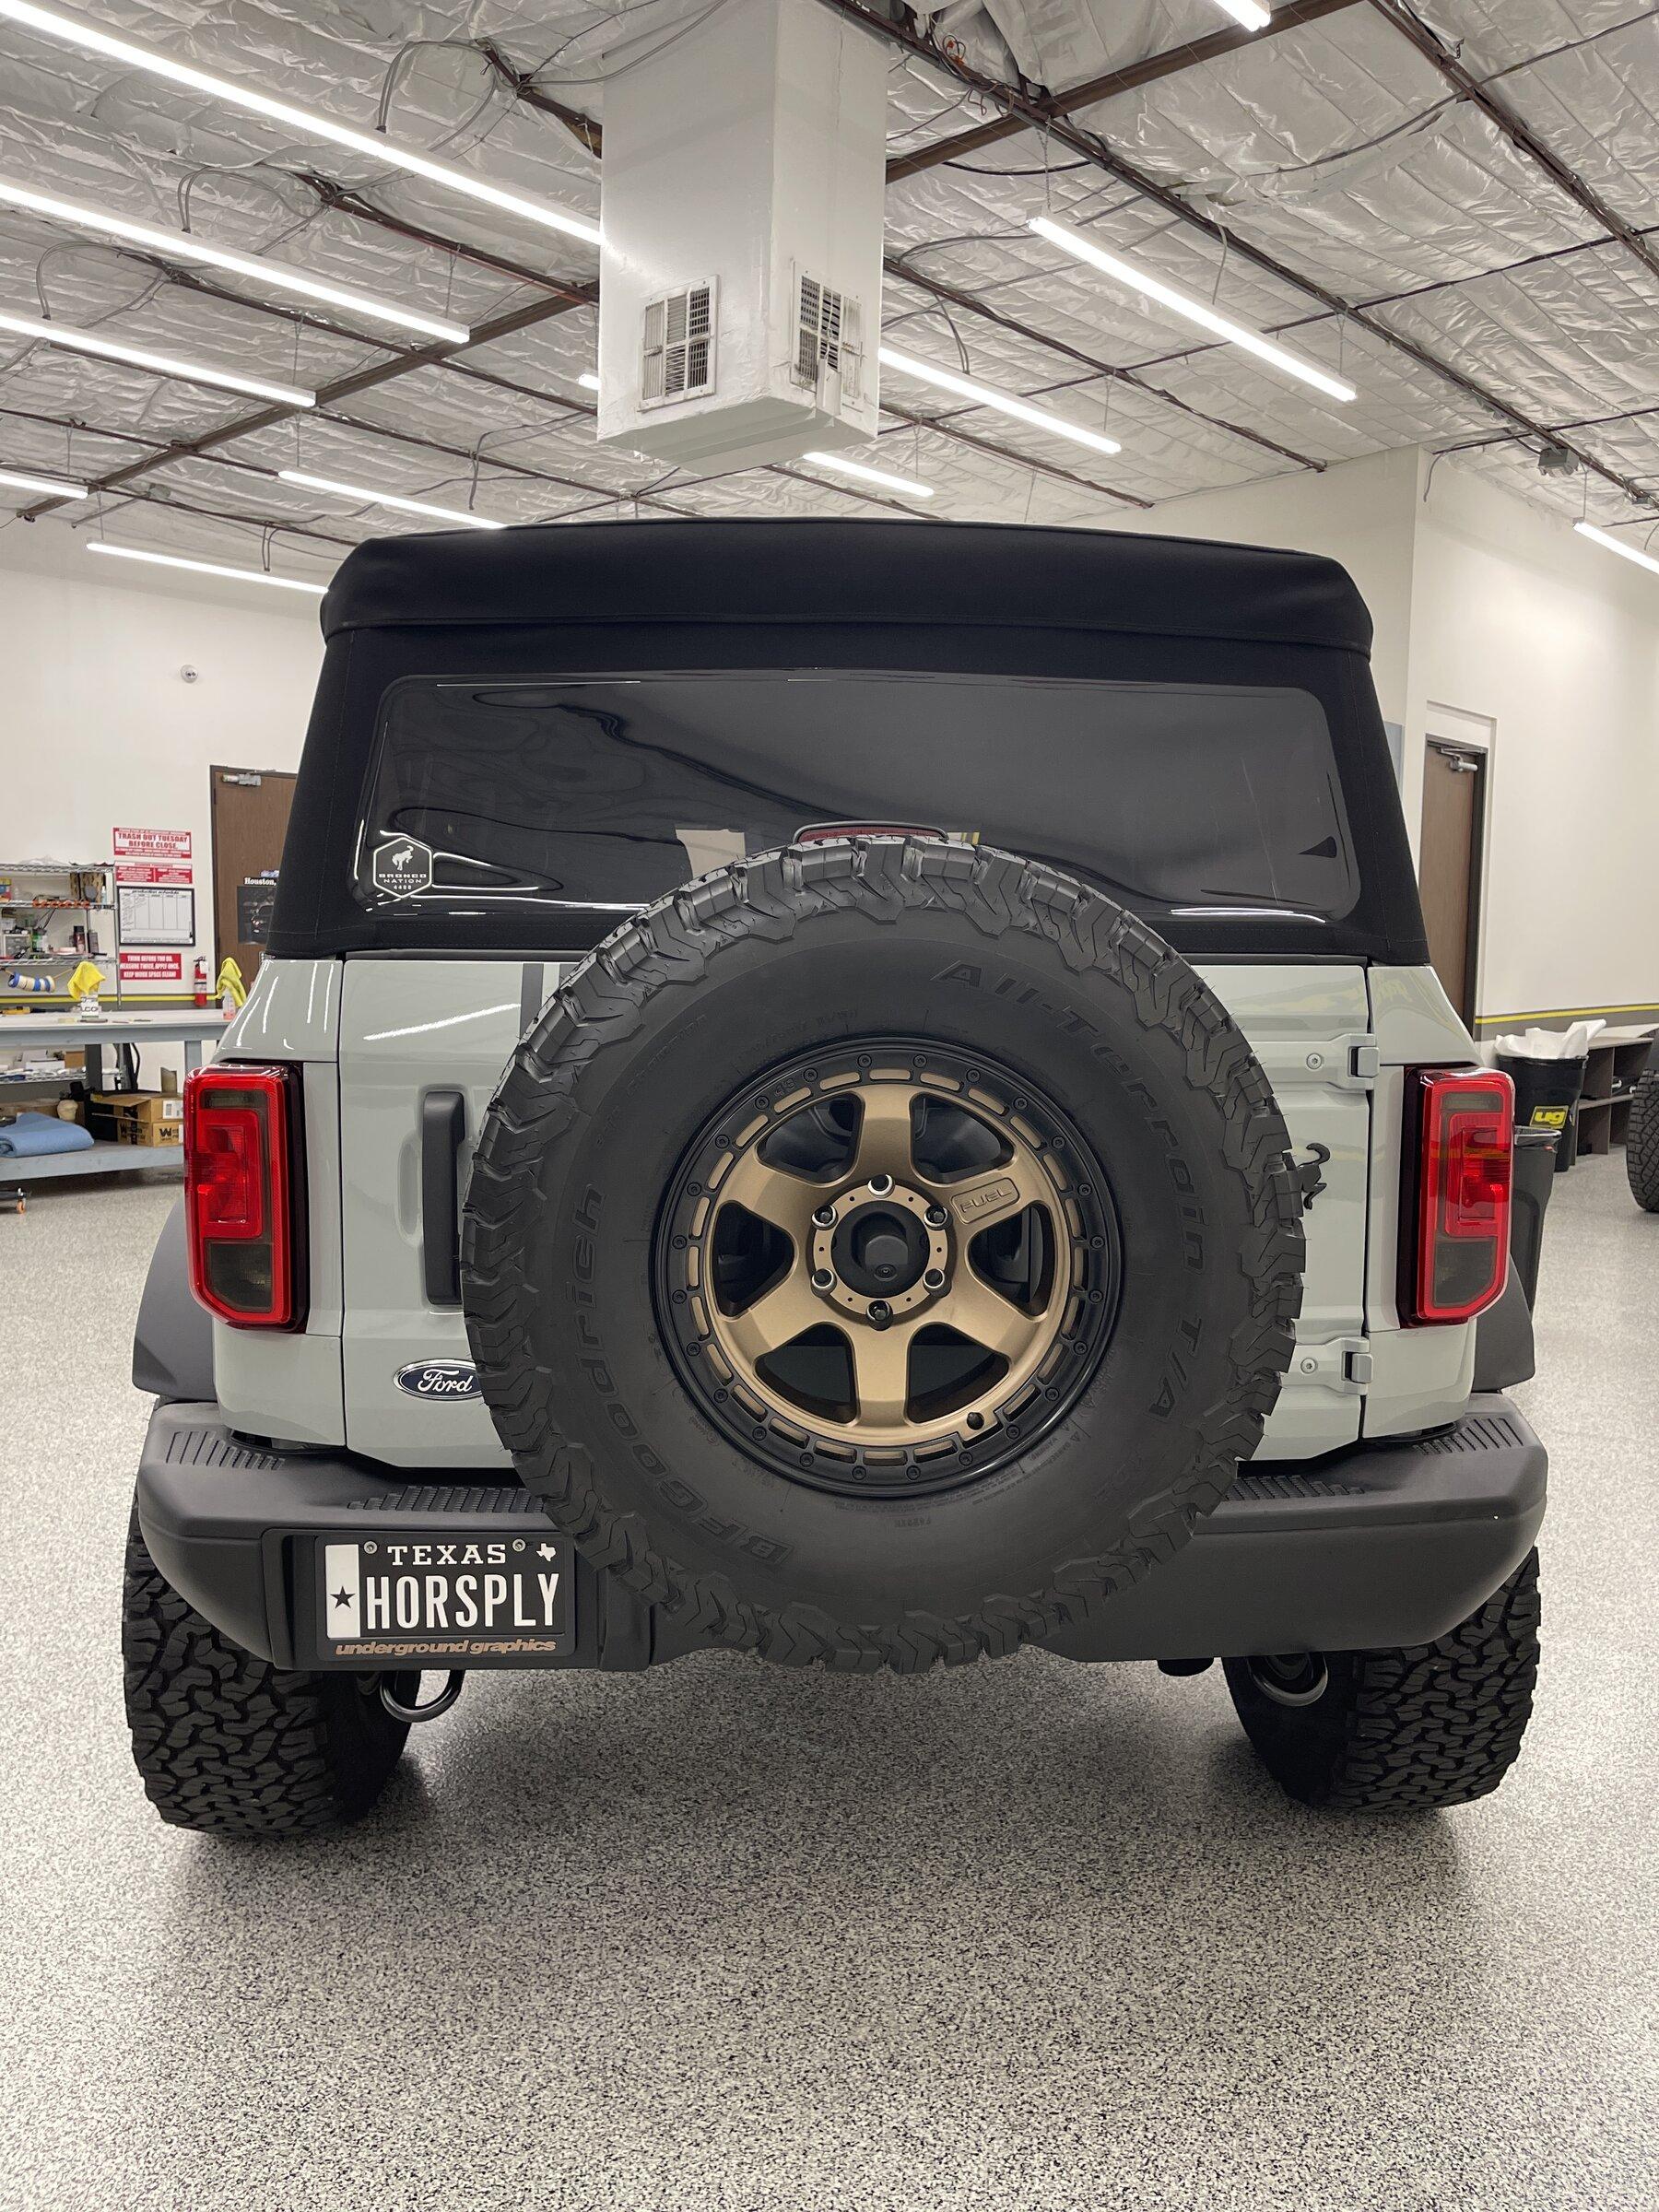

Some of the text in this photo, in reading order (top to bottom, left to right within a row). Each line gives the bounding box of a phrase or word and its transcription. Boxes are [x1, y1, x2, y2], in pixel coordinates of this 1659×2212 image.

[960, 1188, 1012, 1213] FUEL
[418, 1369, 473, 1392] Ford
[387, 1544, 506, 1566] TEXAS
[366, 1573, 559, 1630] HORSPLY
[335, 1639, 556, 1656] underground graphics
